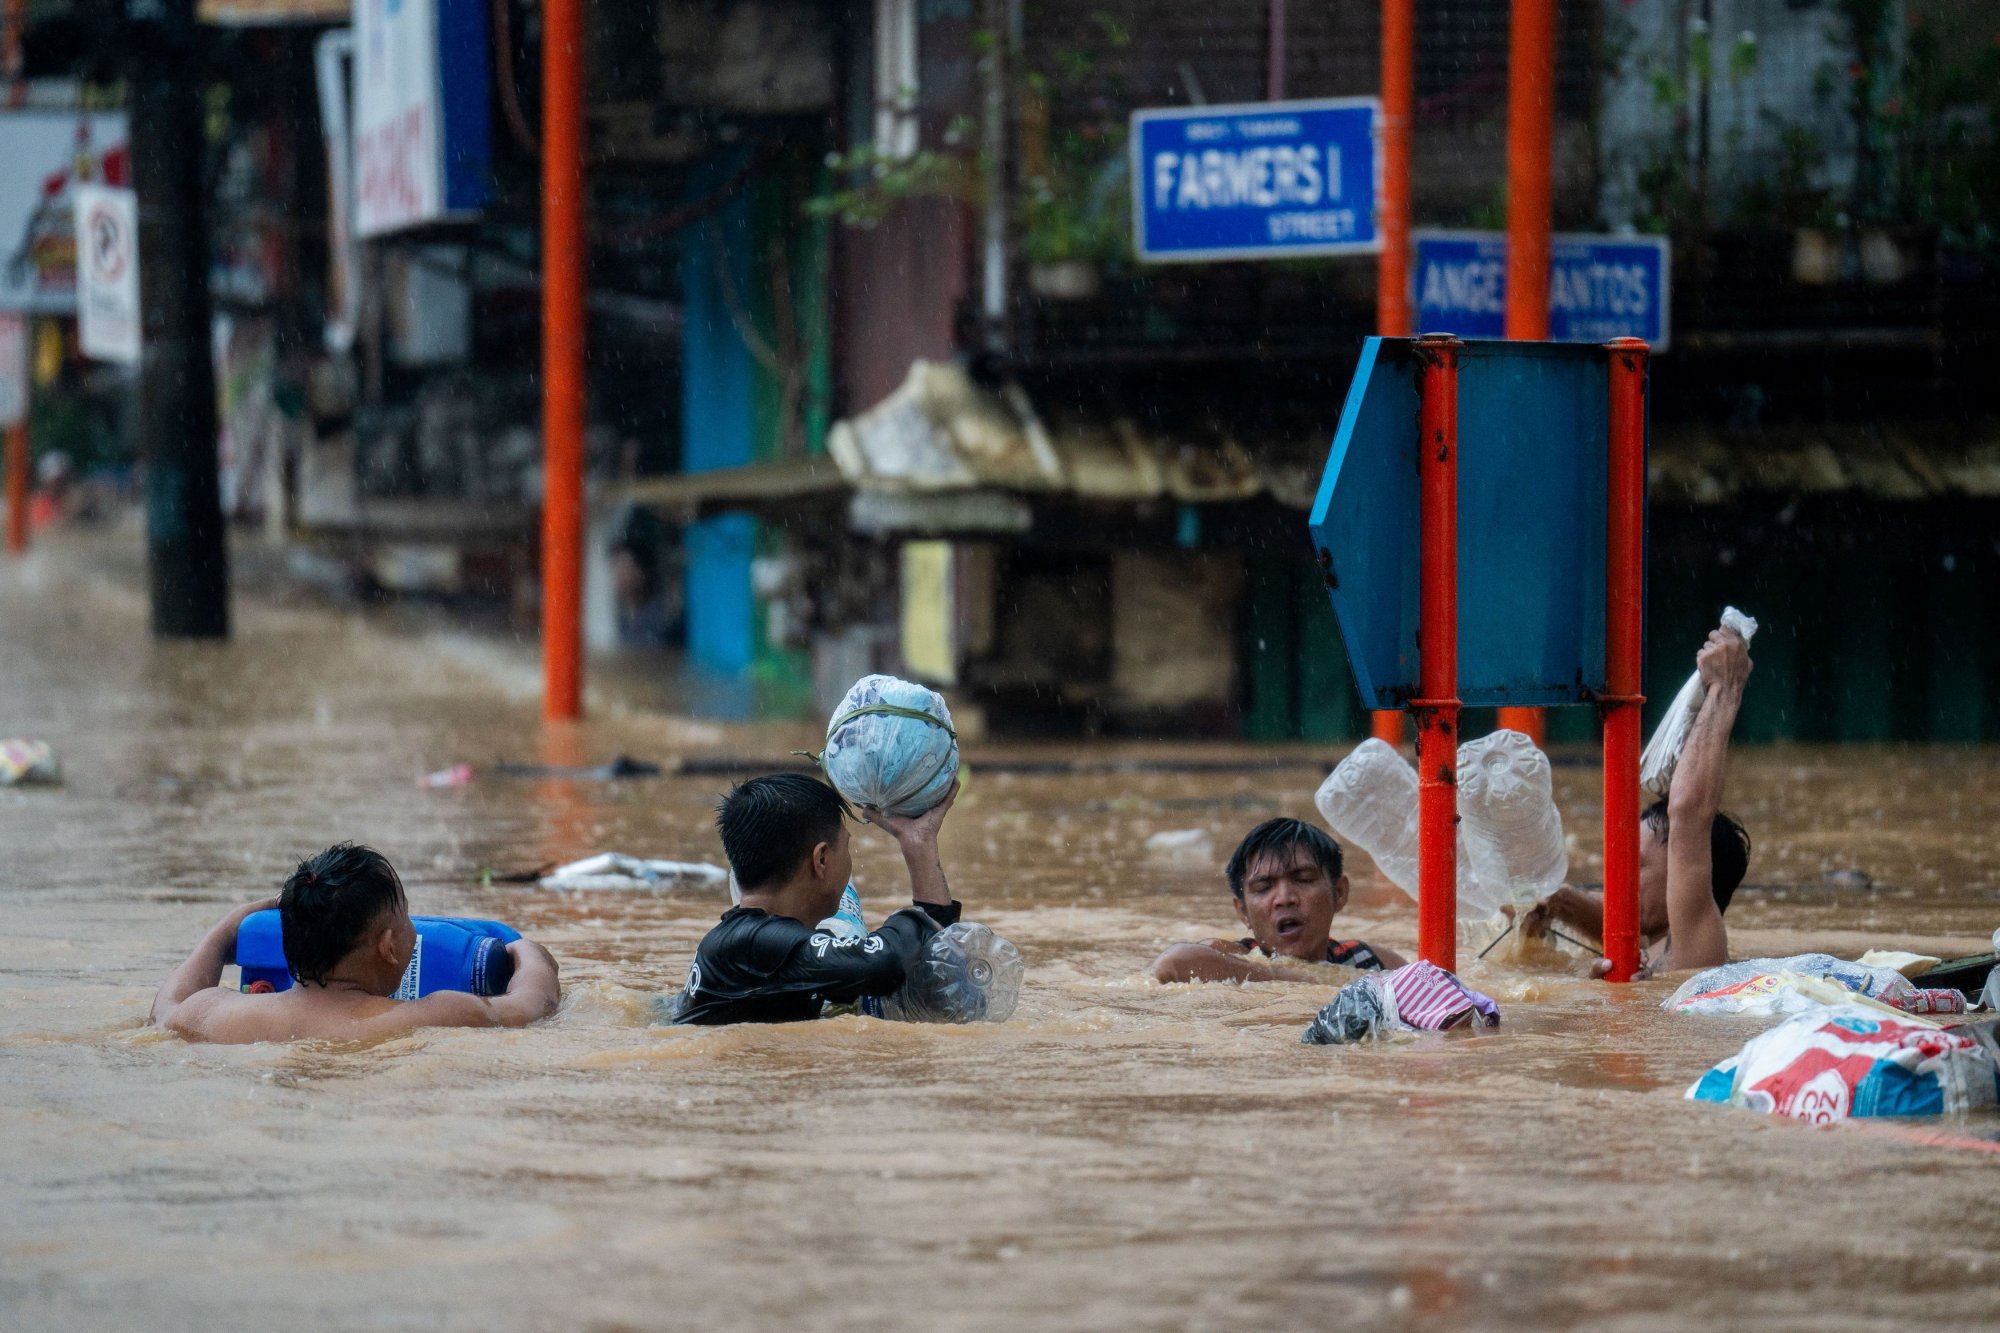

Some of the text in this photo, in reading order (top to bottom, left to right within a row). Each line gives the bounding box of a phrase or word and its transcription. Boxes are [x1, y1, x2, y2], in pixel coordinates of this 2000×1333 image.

[1154, 142, 1342, 211] FARMERS I
[1267, 209, 1357, 242] STREET
[1421, 261, 1649, 315] ANGE ANTOS
